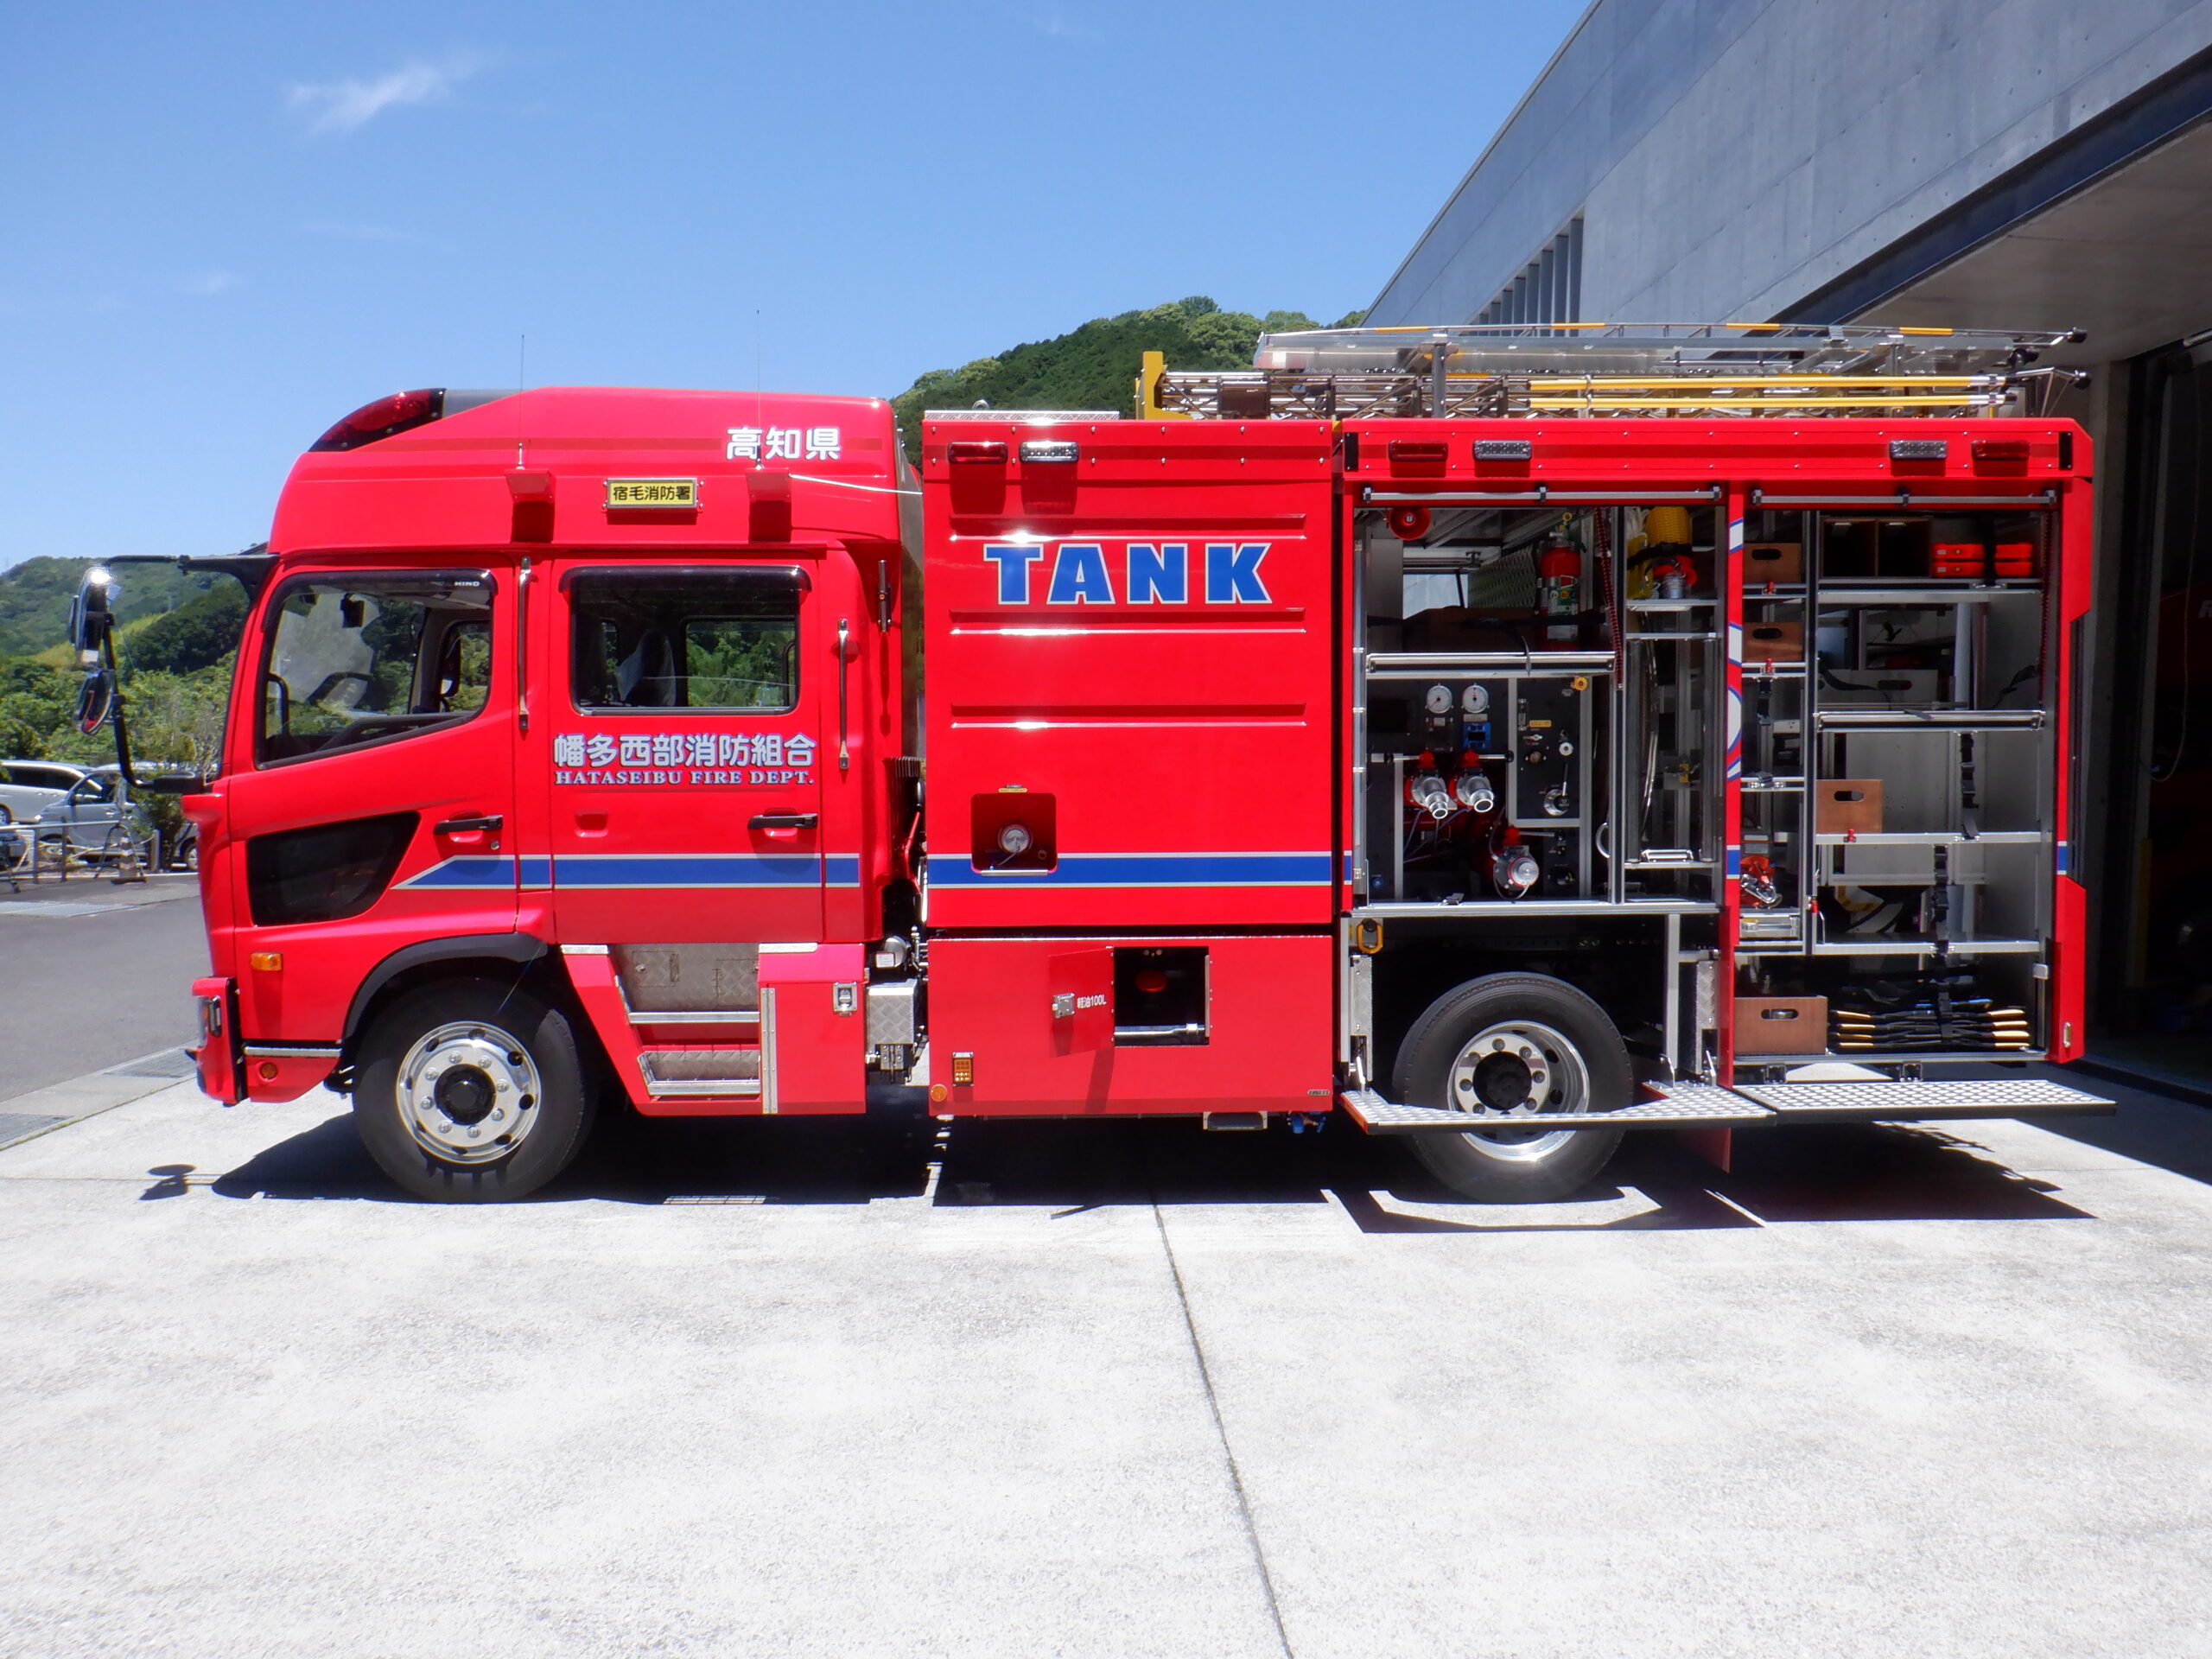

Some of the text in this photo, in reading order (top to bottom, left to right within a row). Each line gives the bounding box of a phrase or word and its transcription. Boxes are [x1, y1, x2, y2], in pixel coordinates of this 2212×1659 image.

[726, 427, 841, 460] 高知県
[613, 486, 690, 501] 宿毛消防署
[983, 543, 1273, 605] TANK
[554, 734, 816, 766] 幡多西部消防組合
[555, 771, 814, 785] HATASEIBU FIRE DEPT.
